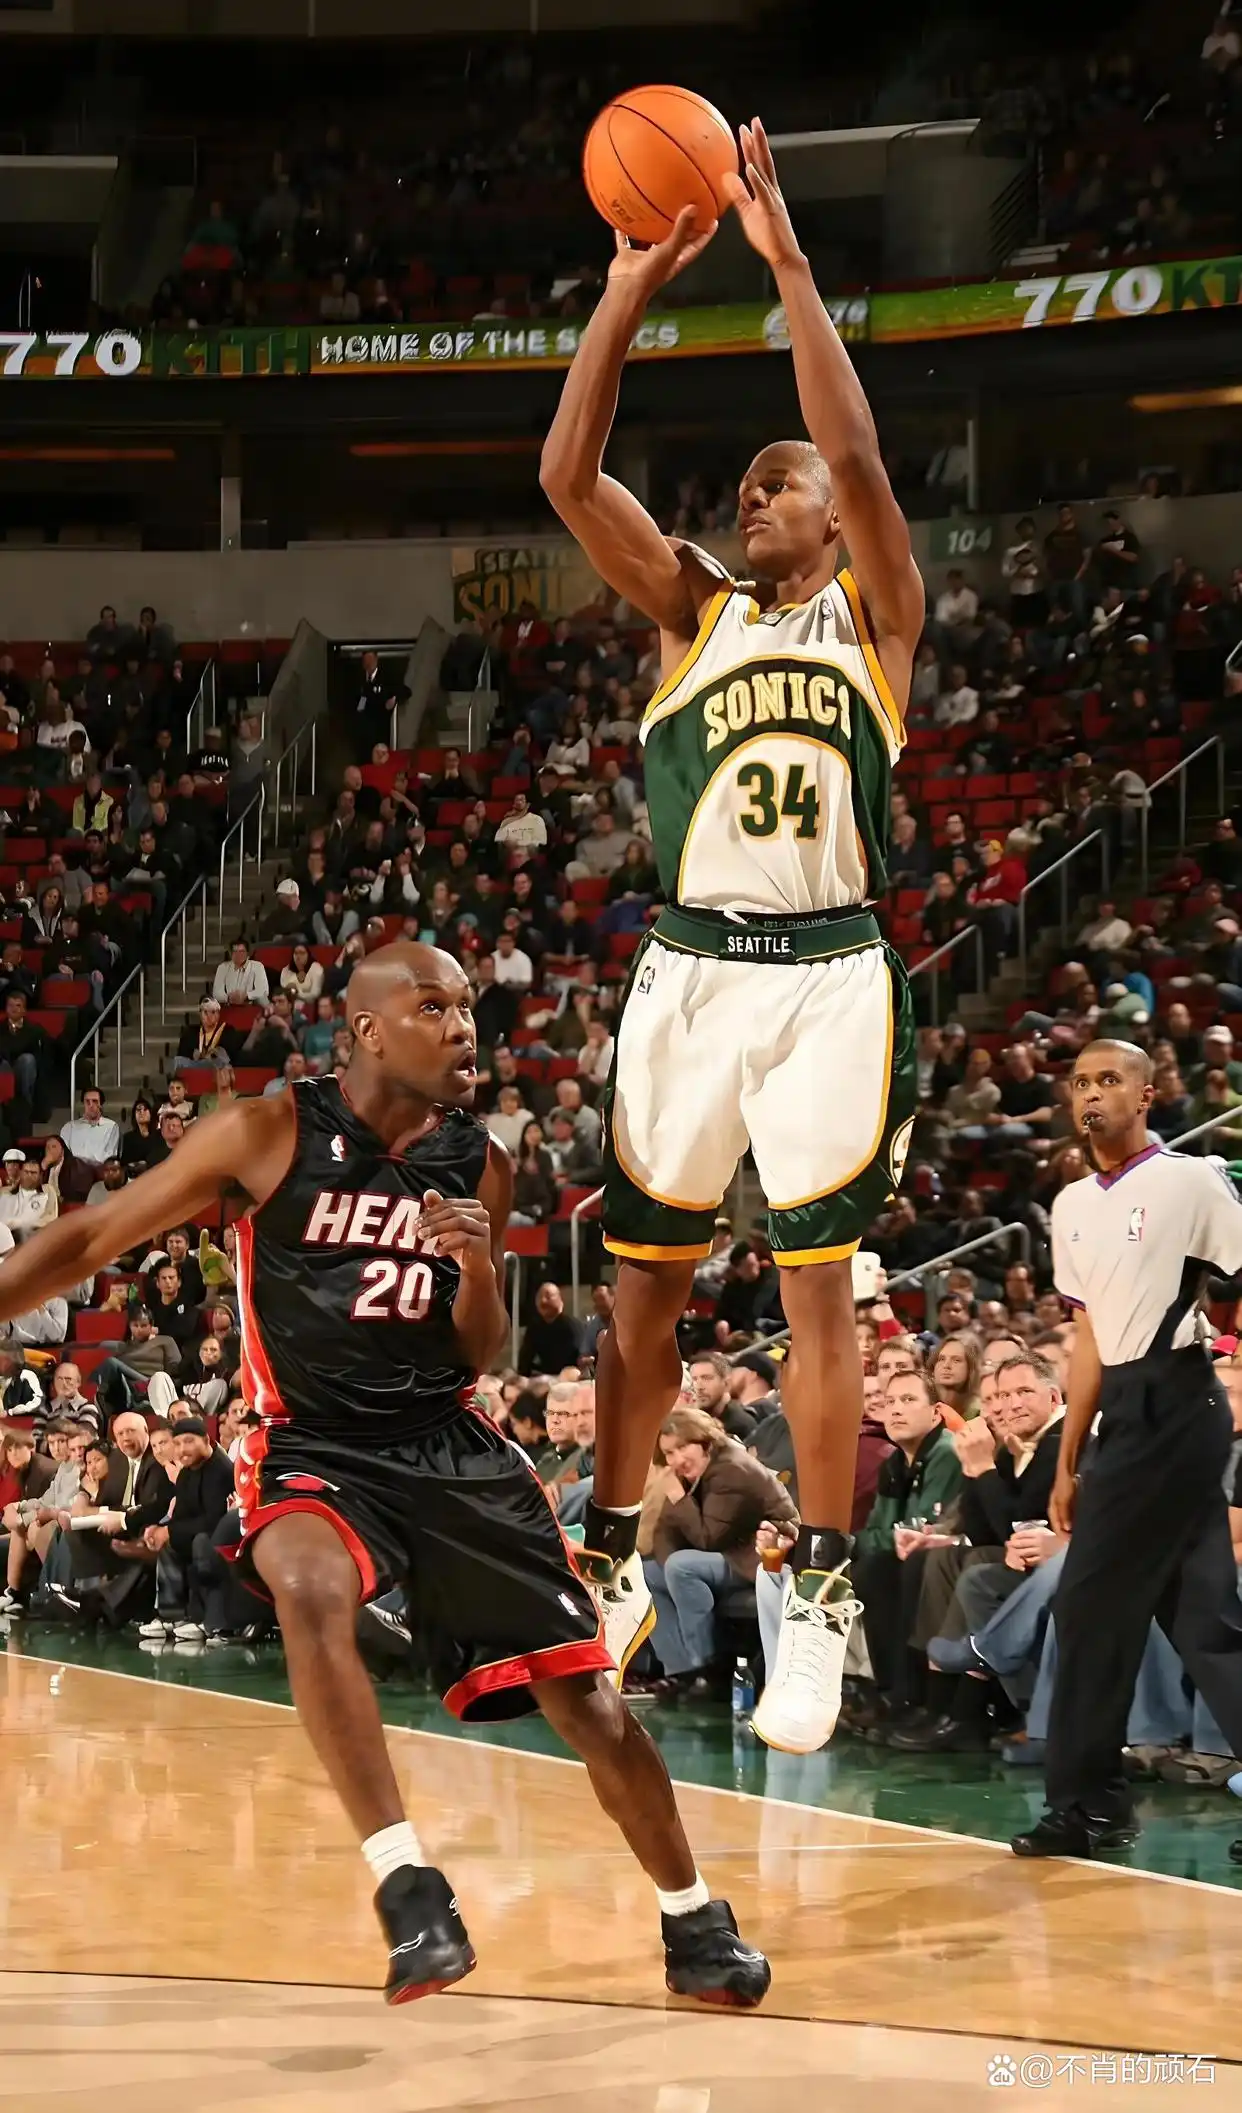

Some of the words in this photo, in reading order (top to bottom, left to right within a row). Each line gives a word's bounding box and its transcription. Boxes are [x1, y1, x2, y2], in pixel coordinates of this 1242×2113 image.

[1014, 266, 1163, 328] 770
[0, 330, 141, 376] 770
[320, 333, 420, 364] HOME
[429, 331, 474, 360] OF
[485, 329, 547, 357] THE
[556, 321, 680, 355] SCS
[947, 526, 993, 555] 104
[737, 762, 820, 838] 34
[727, 935, 790, 953] SEATTLE
[353, 1259, 433, 1319] 20
